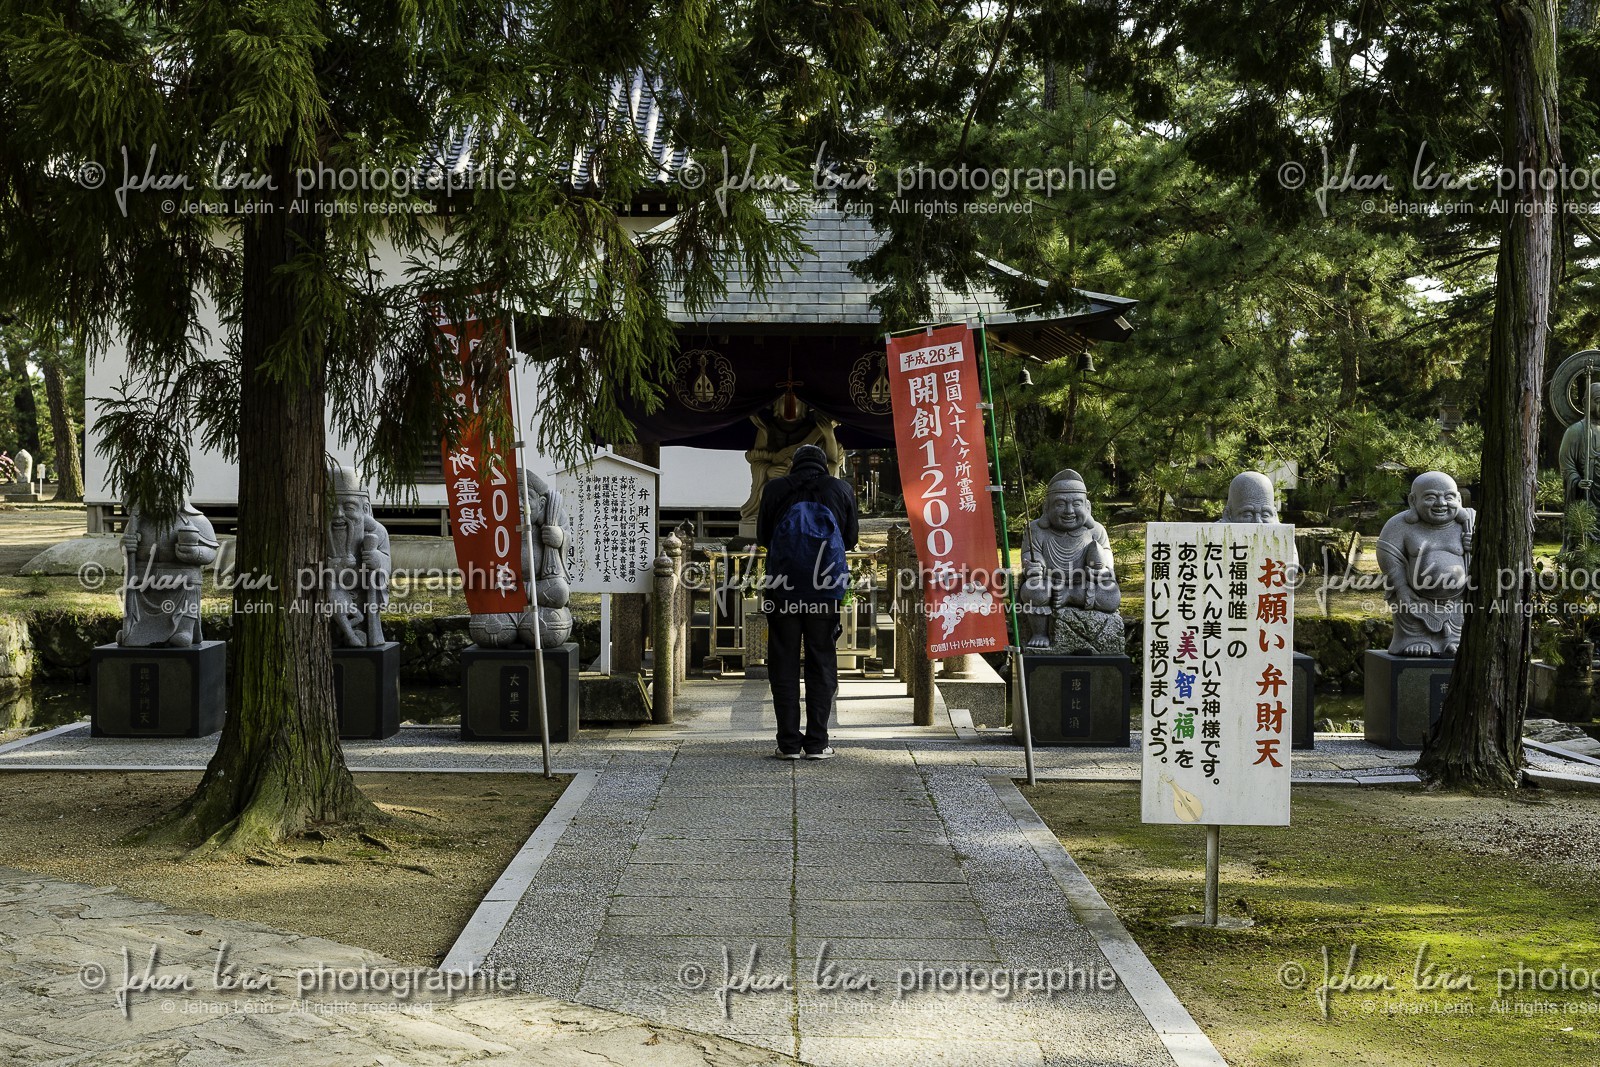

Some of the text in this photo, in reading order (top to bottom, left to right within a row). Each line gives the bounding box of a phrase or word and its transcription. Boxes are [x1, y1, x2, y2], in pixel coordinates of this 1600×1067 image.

[904, 346, 960, 367] 平成26年
[908, 372, 963, 590] 開創1200年
[1148, 541, 1171, 765] お願いして授りましょう。
[1172, 541, 1200, 769] あなたも「美」「智」「福」を
[1200, 541, 1224, 786] たいへん美しい女神様です。
[1227, 542, 1249, 660] 七福神唯一の
